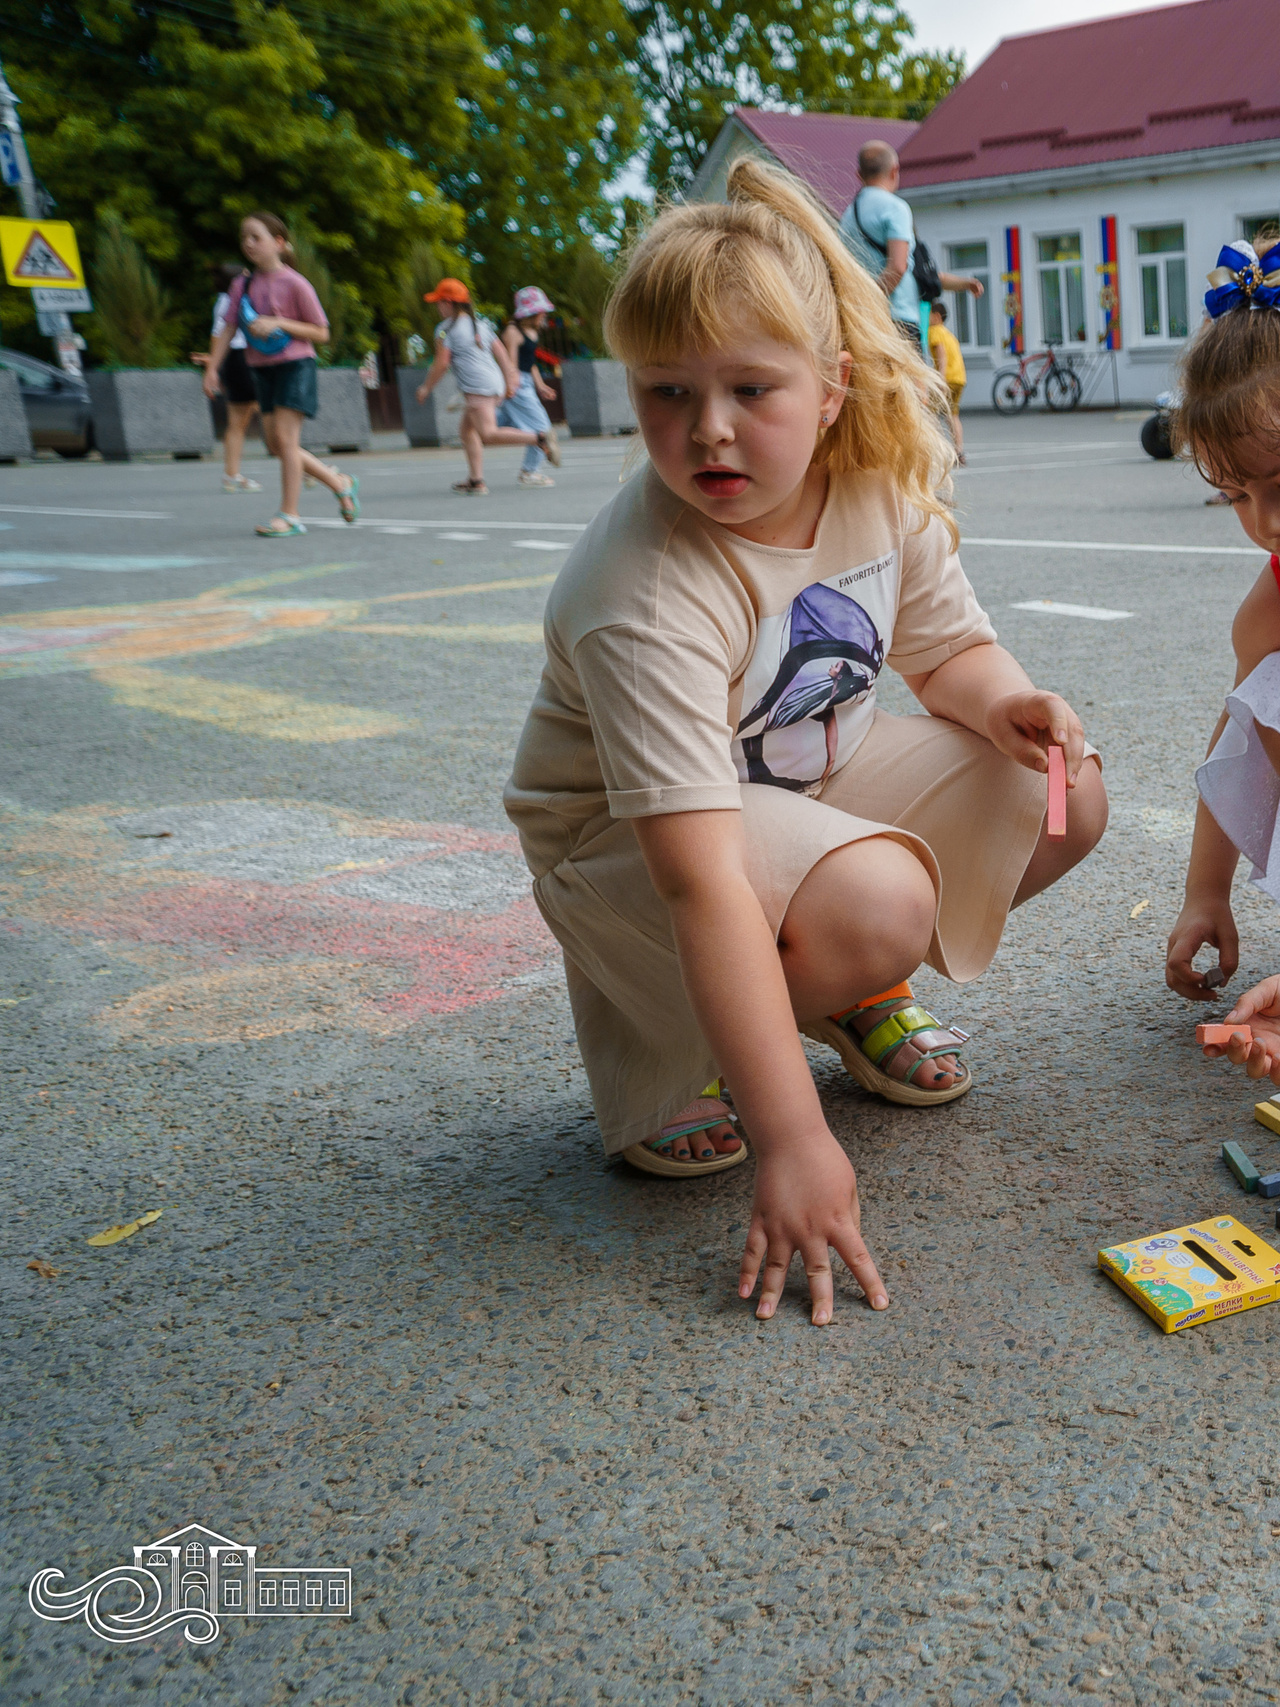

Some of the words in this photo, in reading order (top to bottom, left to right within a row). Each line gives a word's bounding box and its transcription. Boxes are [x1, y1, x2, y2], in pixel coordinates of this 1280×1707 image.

[838, 565, 876, 588] FAVORITE
[1213, 1244, 1238, 1263] МЕЛКИ
[1233, 1260, 1265, 1285] ЦВЕТНЫЕ
[1214, 1296, 1243, 1311] МЕЛКИ
